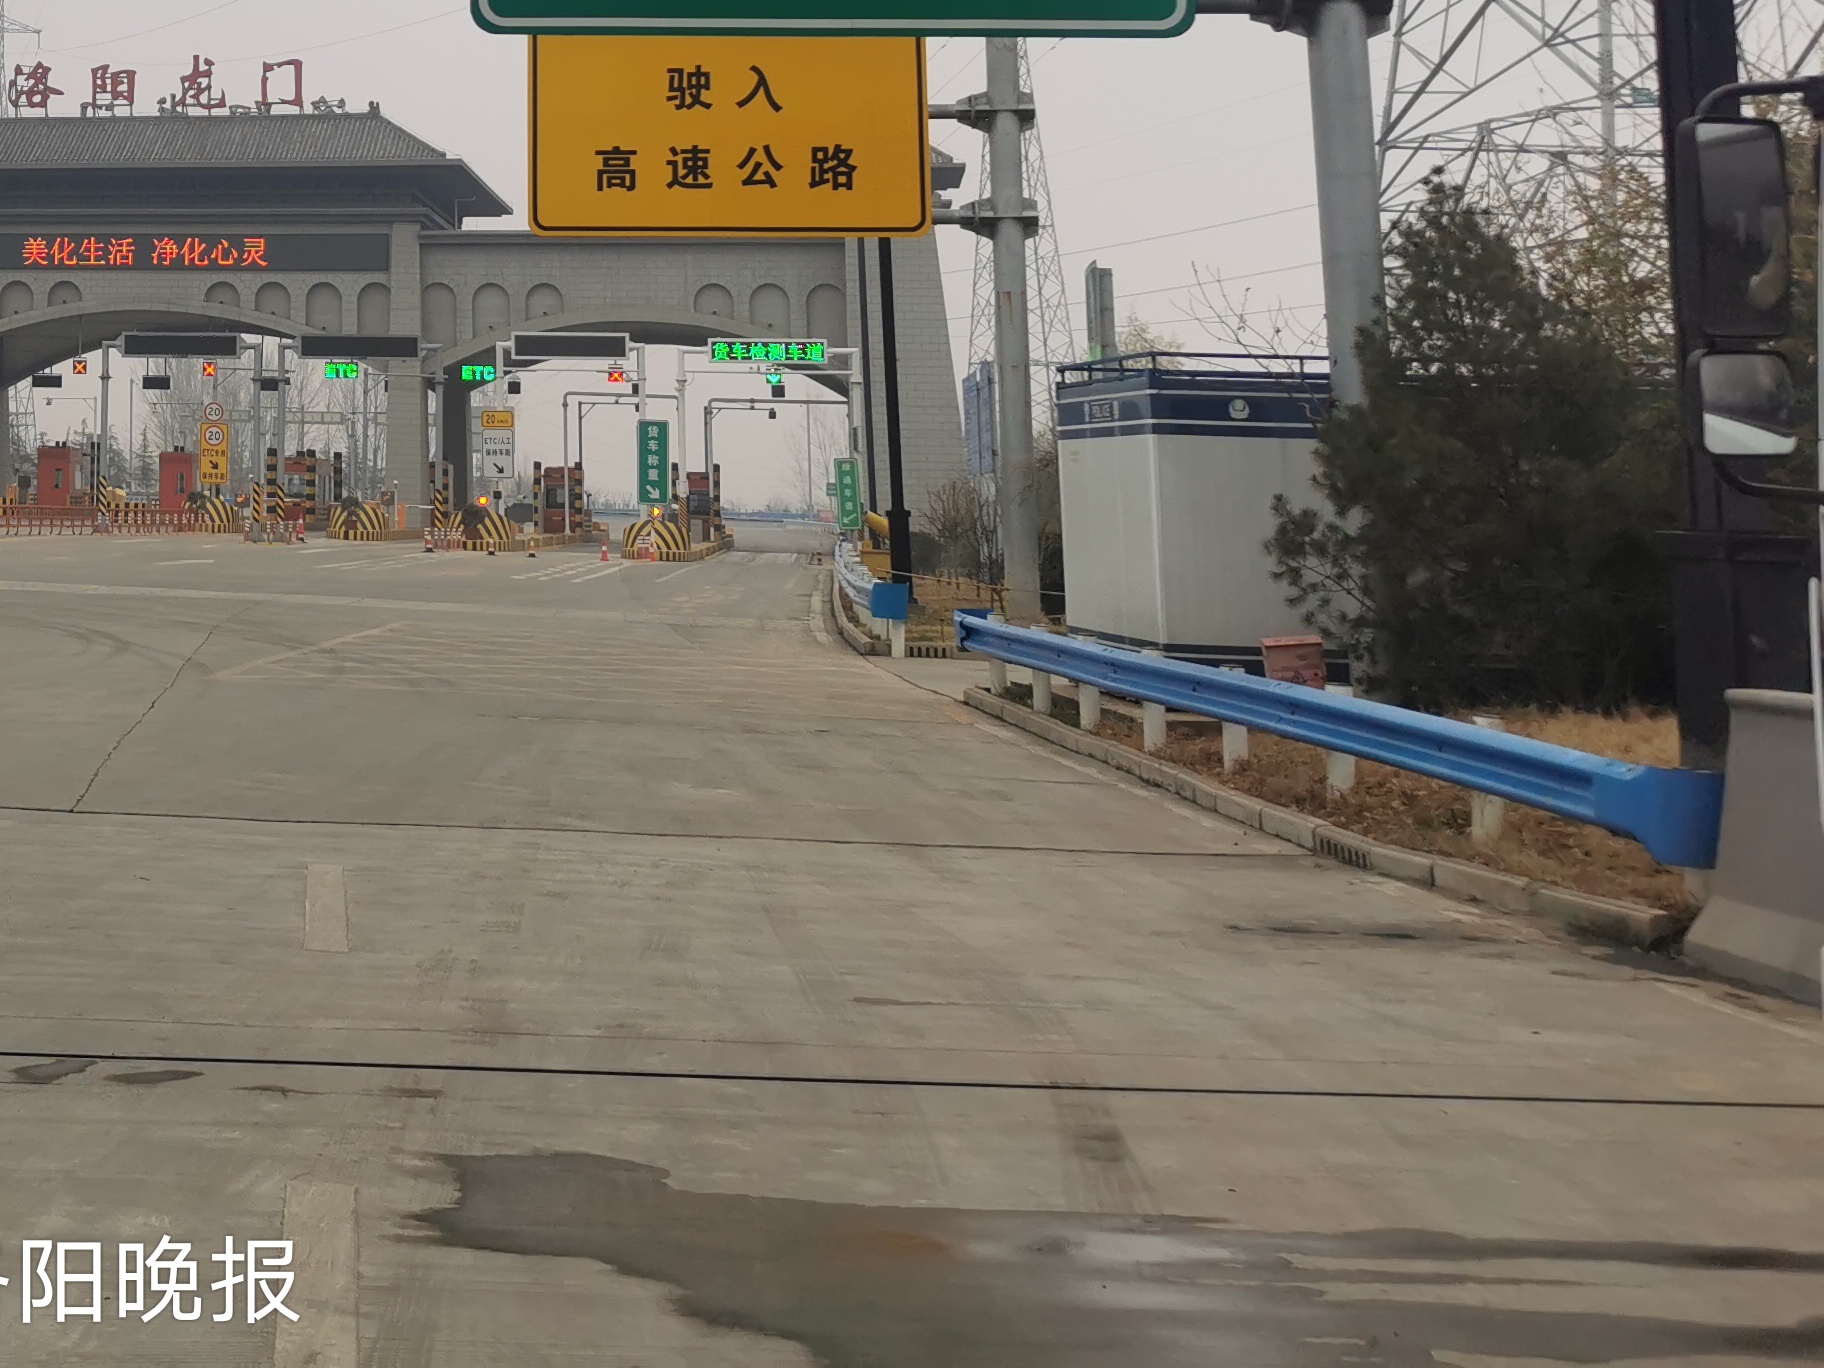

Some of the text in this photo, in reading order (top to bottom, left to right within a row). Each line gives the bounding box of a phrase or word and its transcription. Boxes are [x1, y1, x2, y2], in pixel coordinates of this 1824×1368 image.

[8, 54, 304, 110] 洛阳龙门
[665, 65, 783, 113] 驶入
[594, 143, 858, 193] 高速公路
[22, 236, 268, 267] 美化生活 净化心灵
[712, 341, 825, 362] 货车检测车道
[325, 363, 358, 379] ETC
[461, 365, 495, 381] ETC
[207, 407, 221, 416] 20
[486, 414, 495, 424] 20
[208, 431, 221, 440] 20
[646, 425, 659, 481] 货车称重
